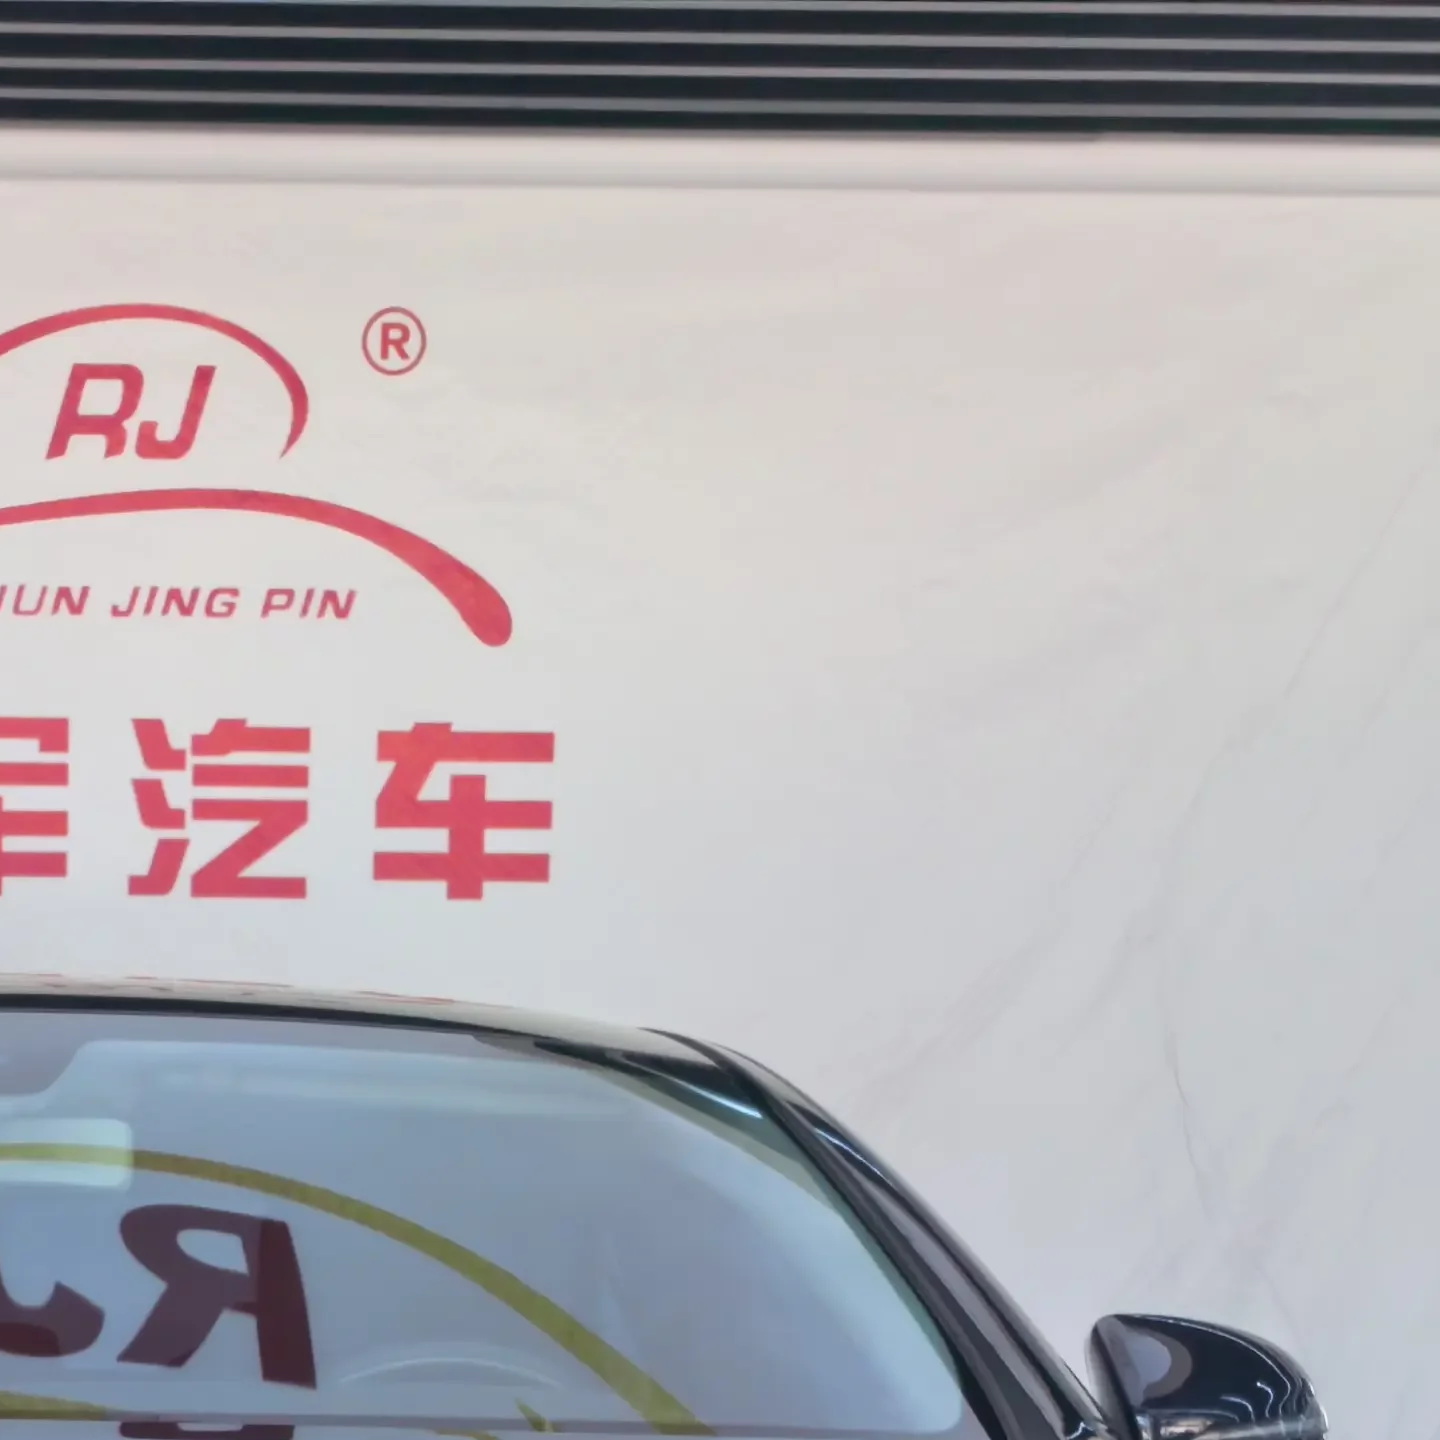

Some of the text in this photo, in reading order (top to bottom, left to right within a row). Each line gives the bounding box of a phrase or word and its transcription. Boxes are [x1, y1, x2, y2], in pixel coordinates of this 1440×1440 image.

[45, 362, 217, 461] RJ
[110, 586, 241, 620] JING
[261, 588, 357, 621] PIN
